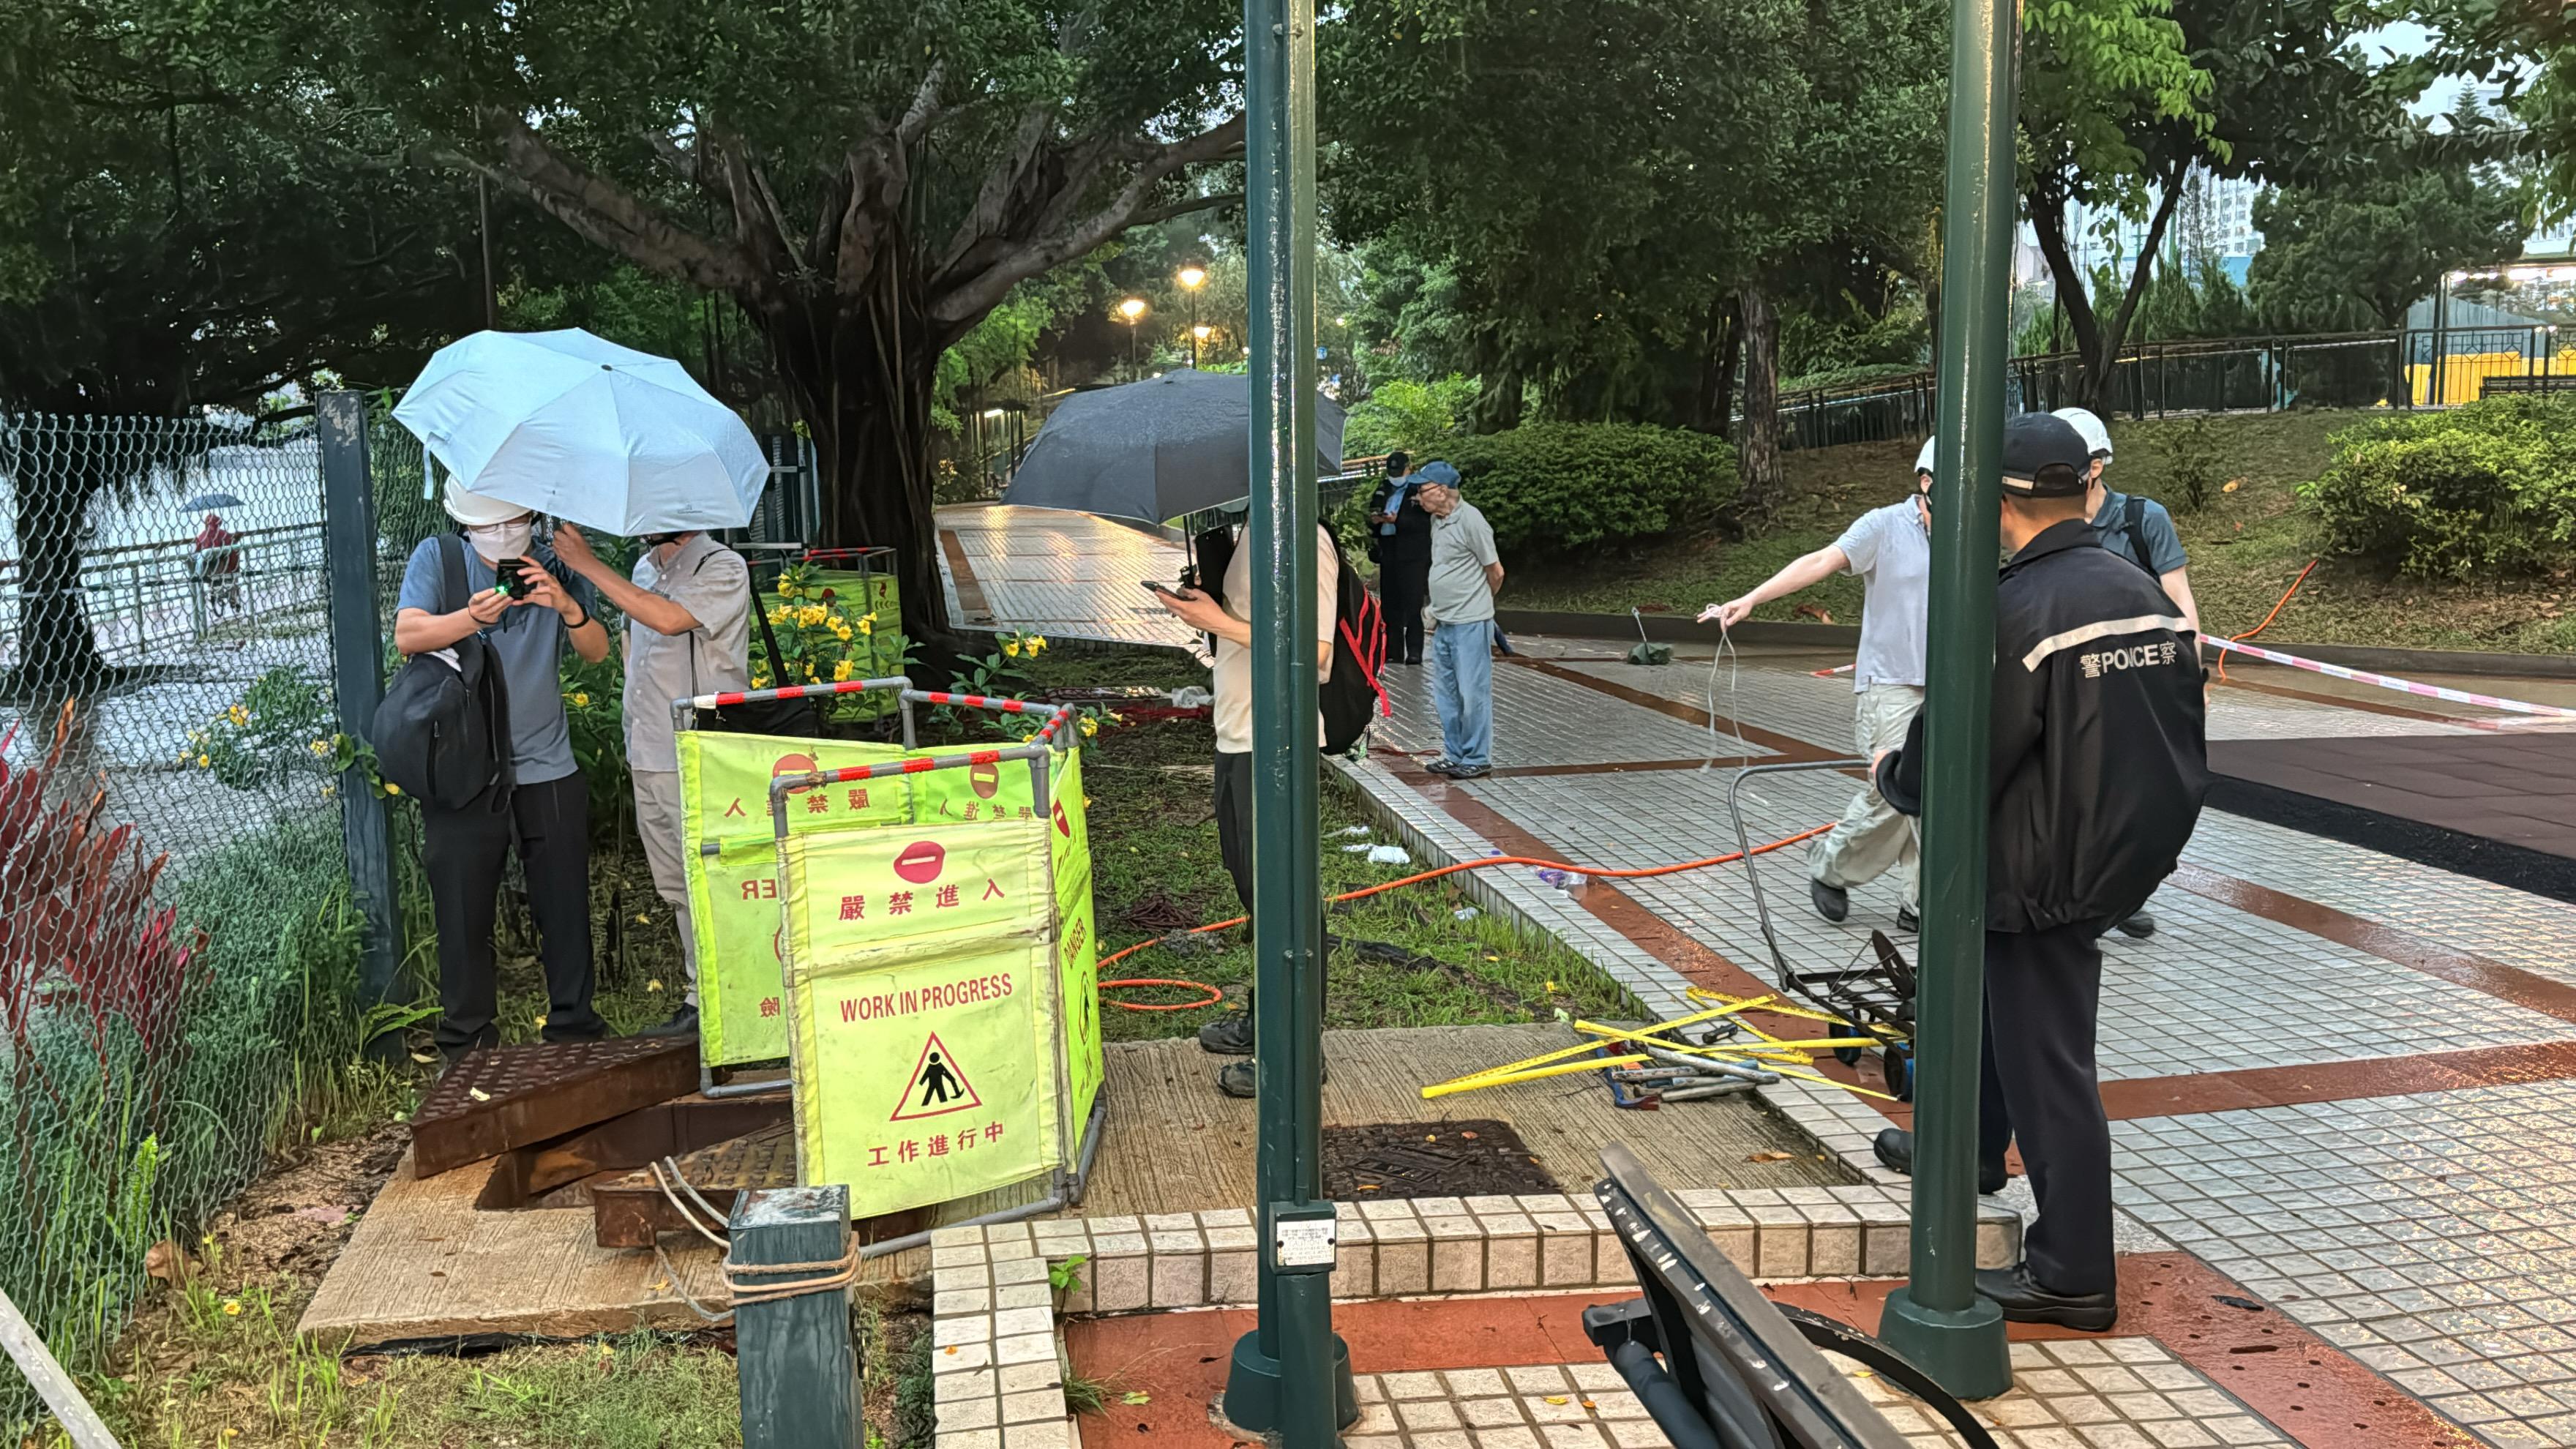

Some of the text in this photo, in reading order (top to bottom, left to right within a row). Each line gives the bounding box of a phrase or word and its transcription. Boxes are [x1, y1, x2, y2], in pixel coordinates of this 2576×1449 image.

[839, 878, 1006, 921] 嚴禁進入
[840, 973, 1012, 1022] WORK IN PROGRESS
[868, 1121, 1003, 1167] 工作進行中
